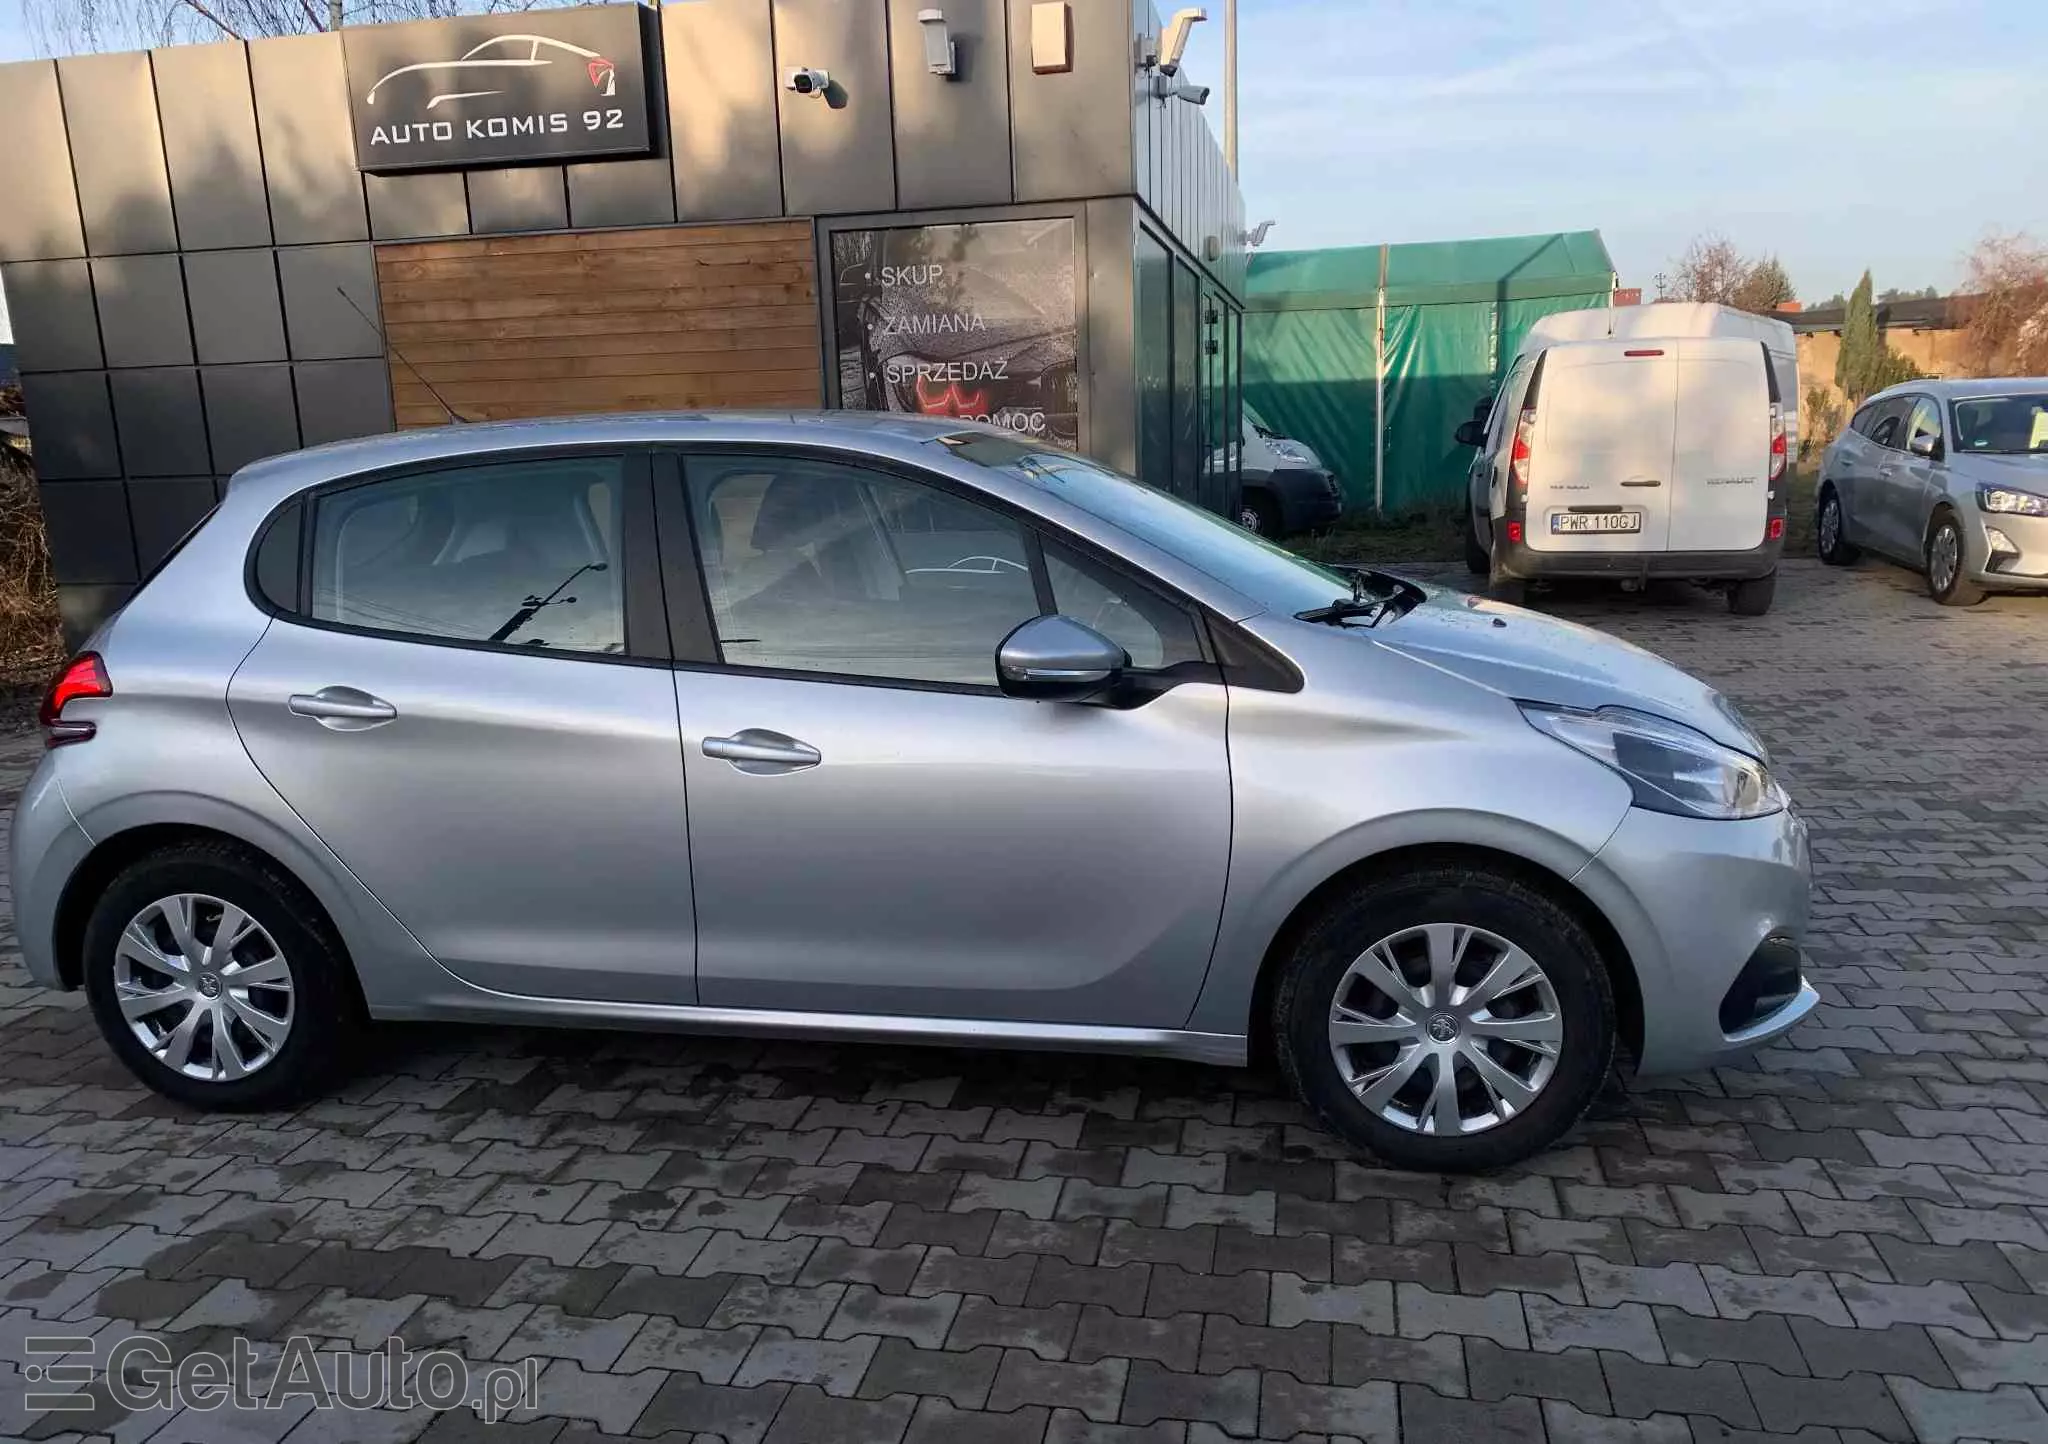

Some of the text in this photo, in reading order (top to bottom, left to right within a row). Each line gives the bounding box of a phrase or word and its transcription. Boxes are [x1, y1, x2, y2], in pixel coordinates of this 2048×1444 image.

[370, 109, 625, 146] AUTO KOMIS 92
[881, 264, 943, 287] SKUP
[884, 313, 987, 336] ZAMIANA
[886, 356, 1009, 384] SPRZEDAŻ
[959, 412, 1046, 432] MOC
[1560, 514, 1637, 530] PWR 110GJ
